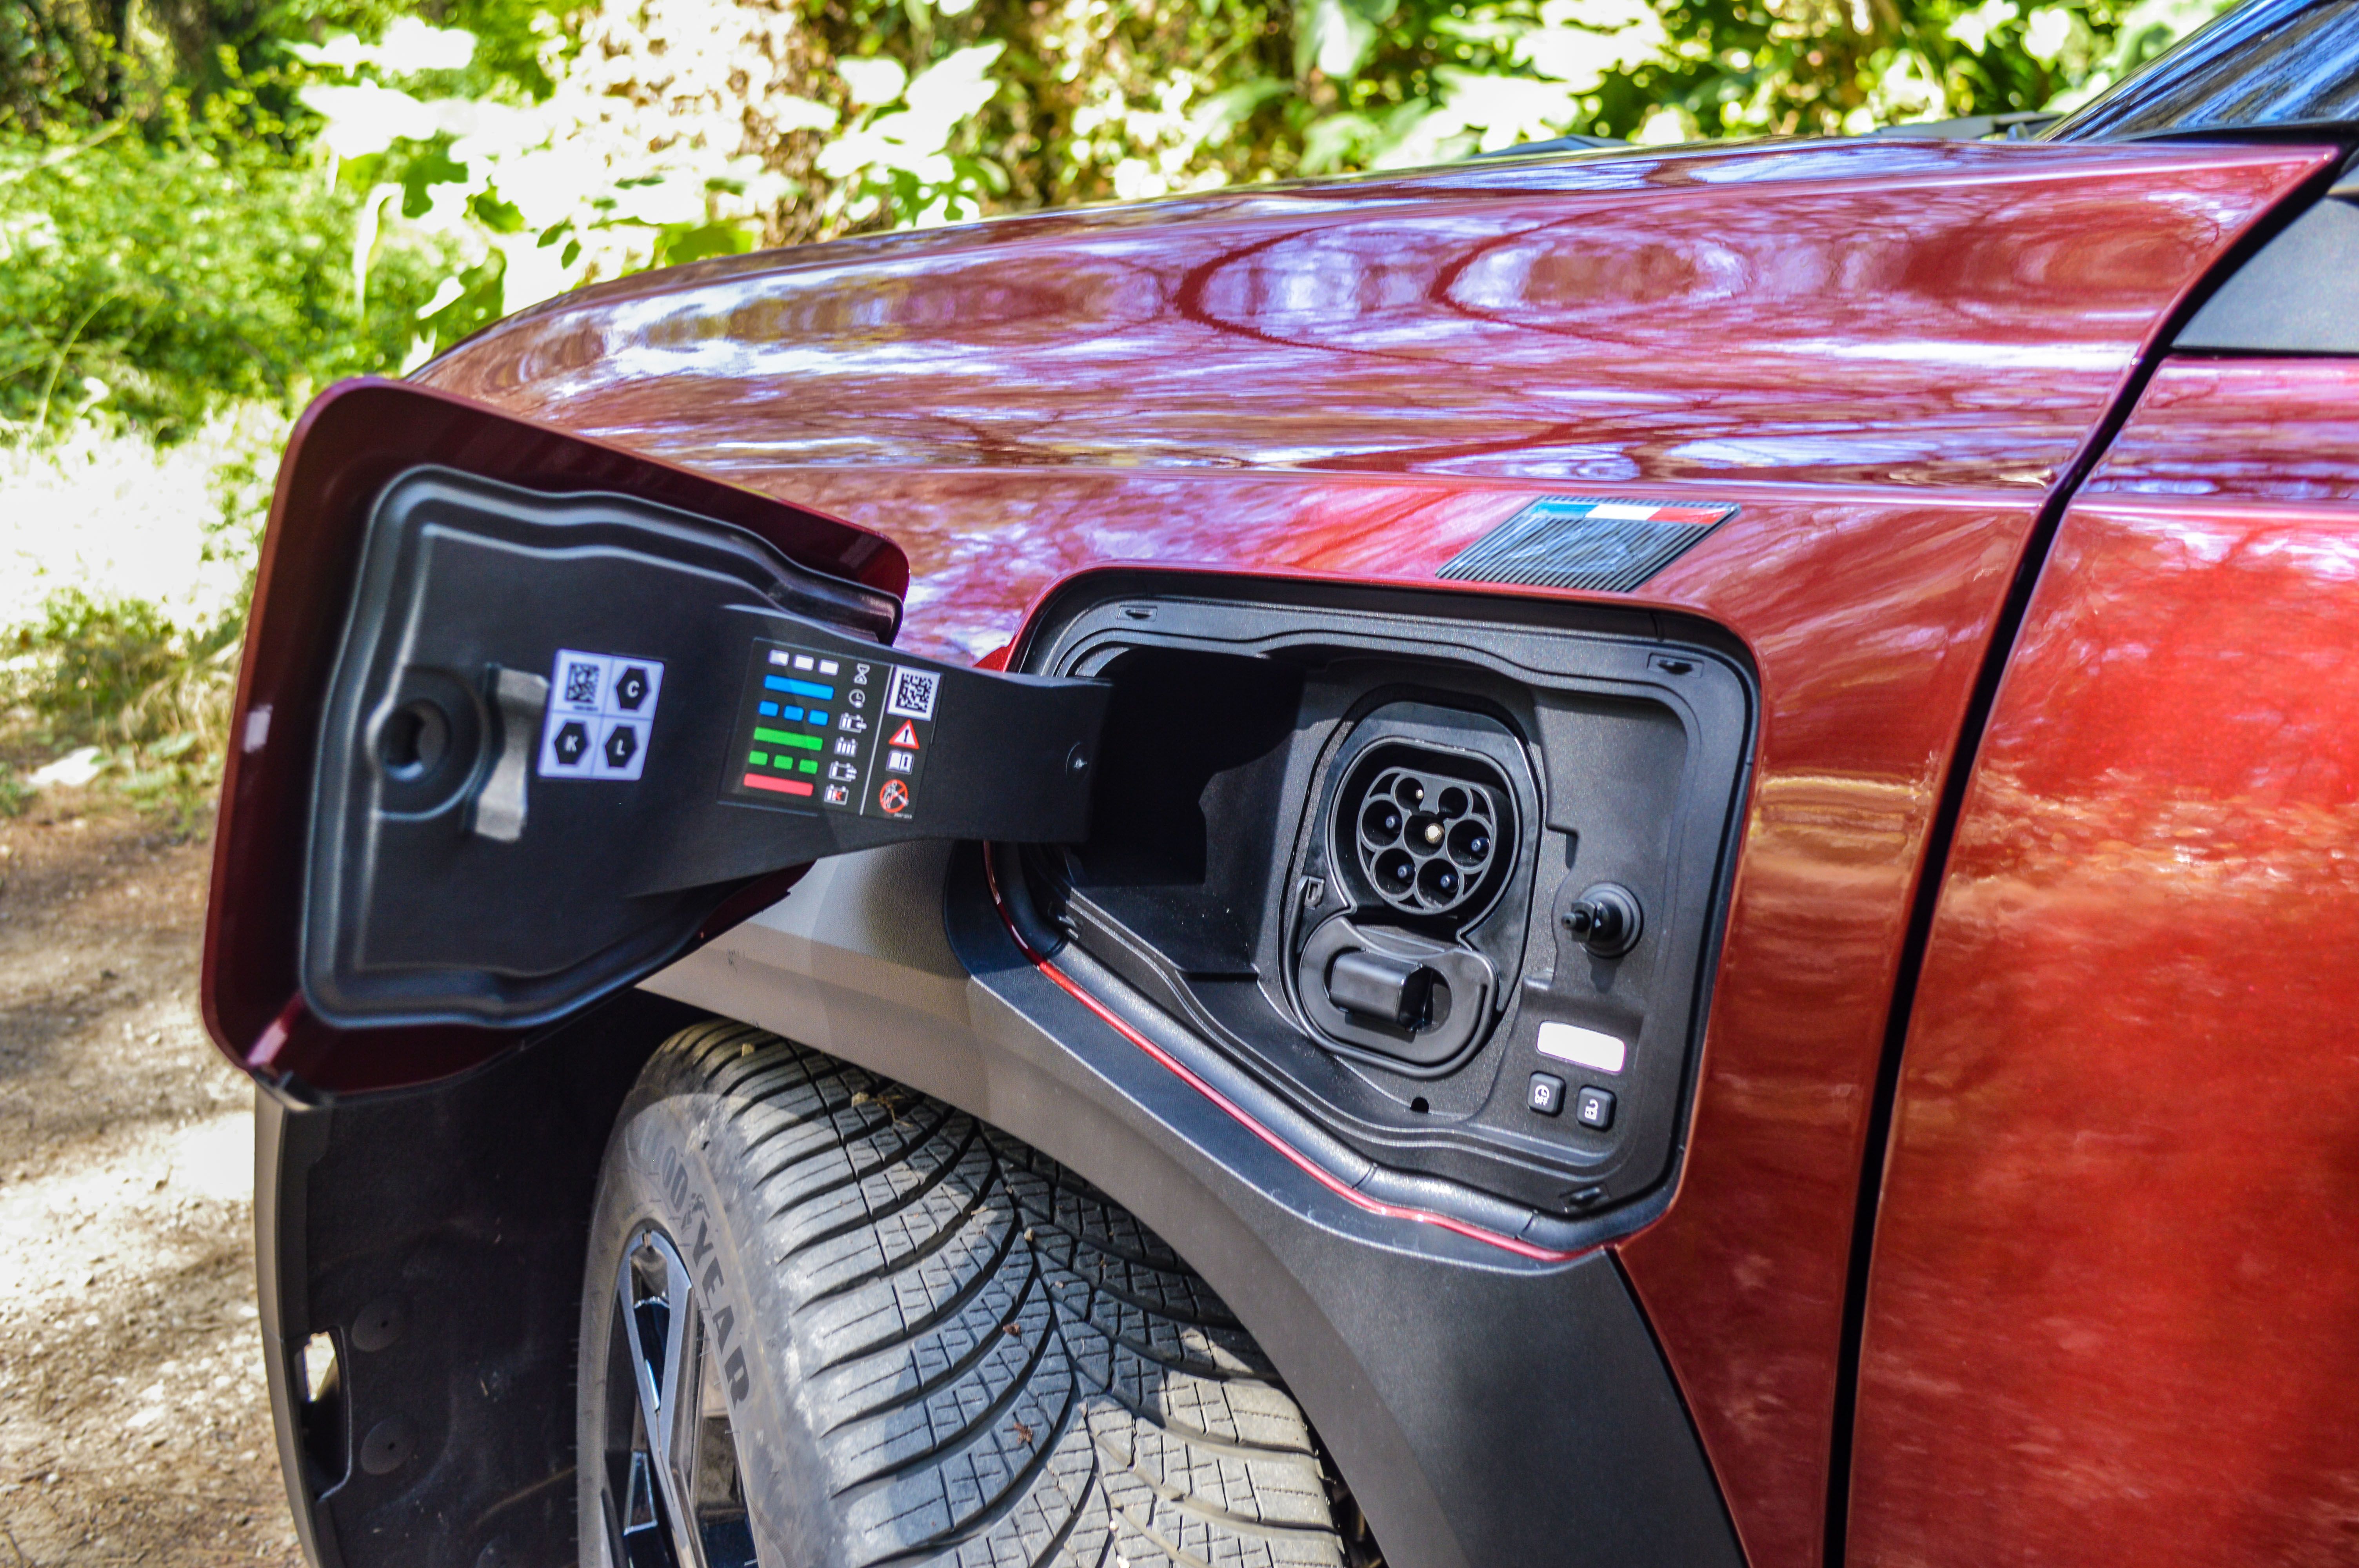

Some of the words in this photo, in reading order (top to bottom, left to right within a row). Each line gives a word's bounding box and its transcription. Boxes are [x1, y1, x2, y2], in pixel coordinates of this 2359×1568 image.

[627, 681, 640, 698] C
[565, 735, 578, 752] K
[616, 739, 625, 756] L
[1534, 1096, 1548, 1106] OFF
[642, 1123, 749, 1410] OODYEAR
